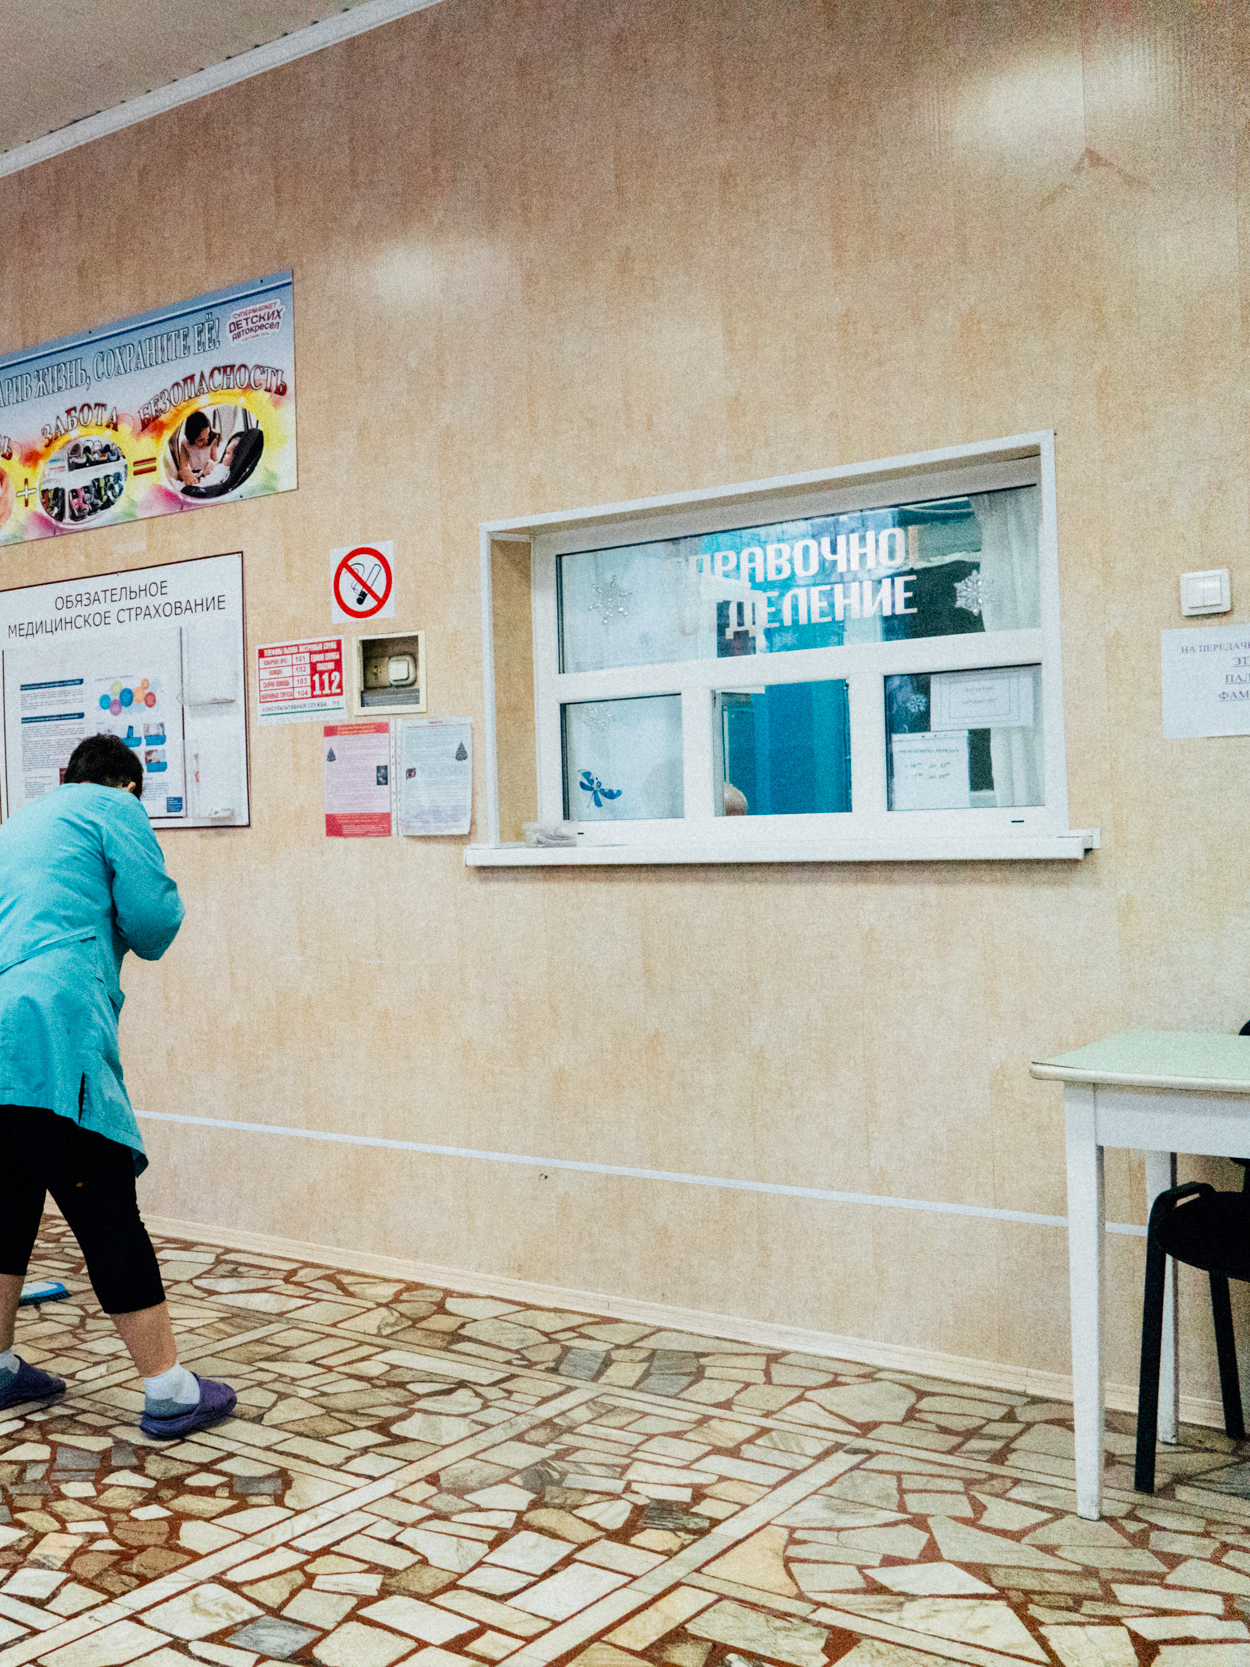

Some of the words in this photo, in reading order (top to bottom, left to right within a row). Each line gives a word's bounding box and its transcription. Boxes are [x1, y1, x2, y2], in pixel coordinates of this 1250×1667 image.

[229, 308, 283, 333] ДЕТСКИХ
[34, 358, 91, 398] ЖИЗНЬ,
[93, 327, 190, 382] СОХРАНИТЕ
[193, 312, 220, 354] ЕЁ!
[138, 364, 288, 432] БЕЗОПАСНОСТЬ
[40, 402, 119, 448] ЗАБОТА
[54, 580, 168, 611] ОБЯЗАТЕЛЬНОЕ
[7, 610, 112, 639] МЕДИЦИНСКОЕ
[116, 594, 226, 624] СТРАХОВАНИЕ
[1181, 645, 1196, 654] НА
[312, 671, 341, 695] 112
